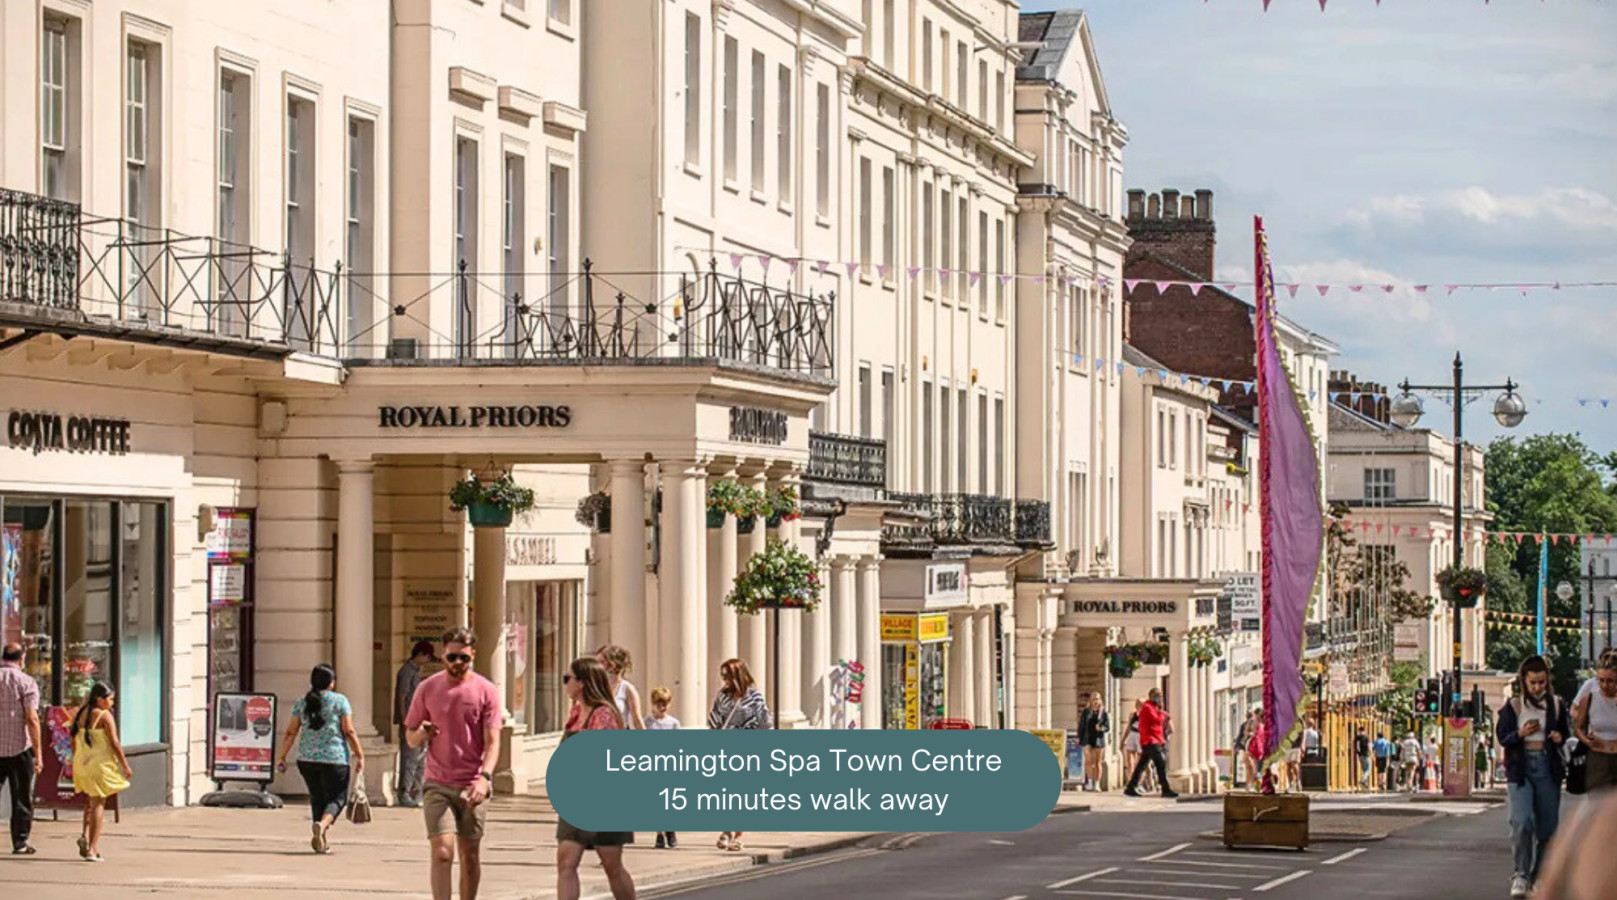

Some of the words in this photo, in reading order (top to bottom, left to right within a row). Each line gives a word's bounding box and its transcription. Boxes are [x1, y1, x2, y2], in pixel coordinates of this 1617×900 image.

[378, 406, 466, 428] ROYAL
[469, 406, 571, 428] PRIORS
[8, 411, 64, 450] COSTA
[67, 416, 131, 453] COFFEE
[1073, 600, 1120, 613] ROYAL
[1121, 600, 1176, 613] PRIORS
